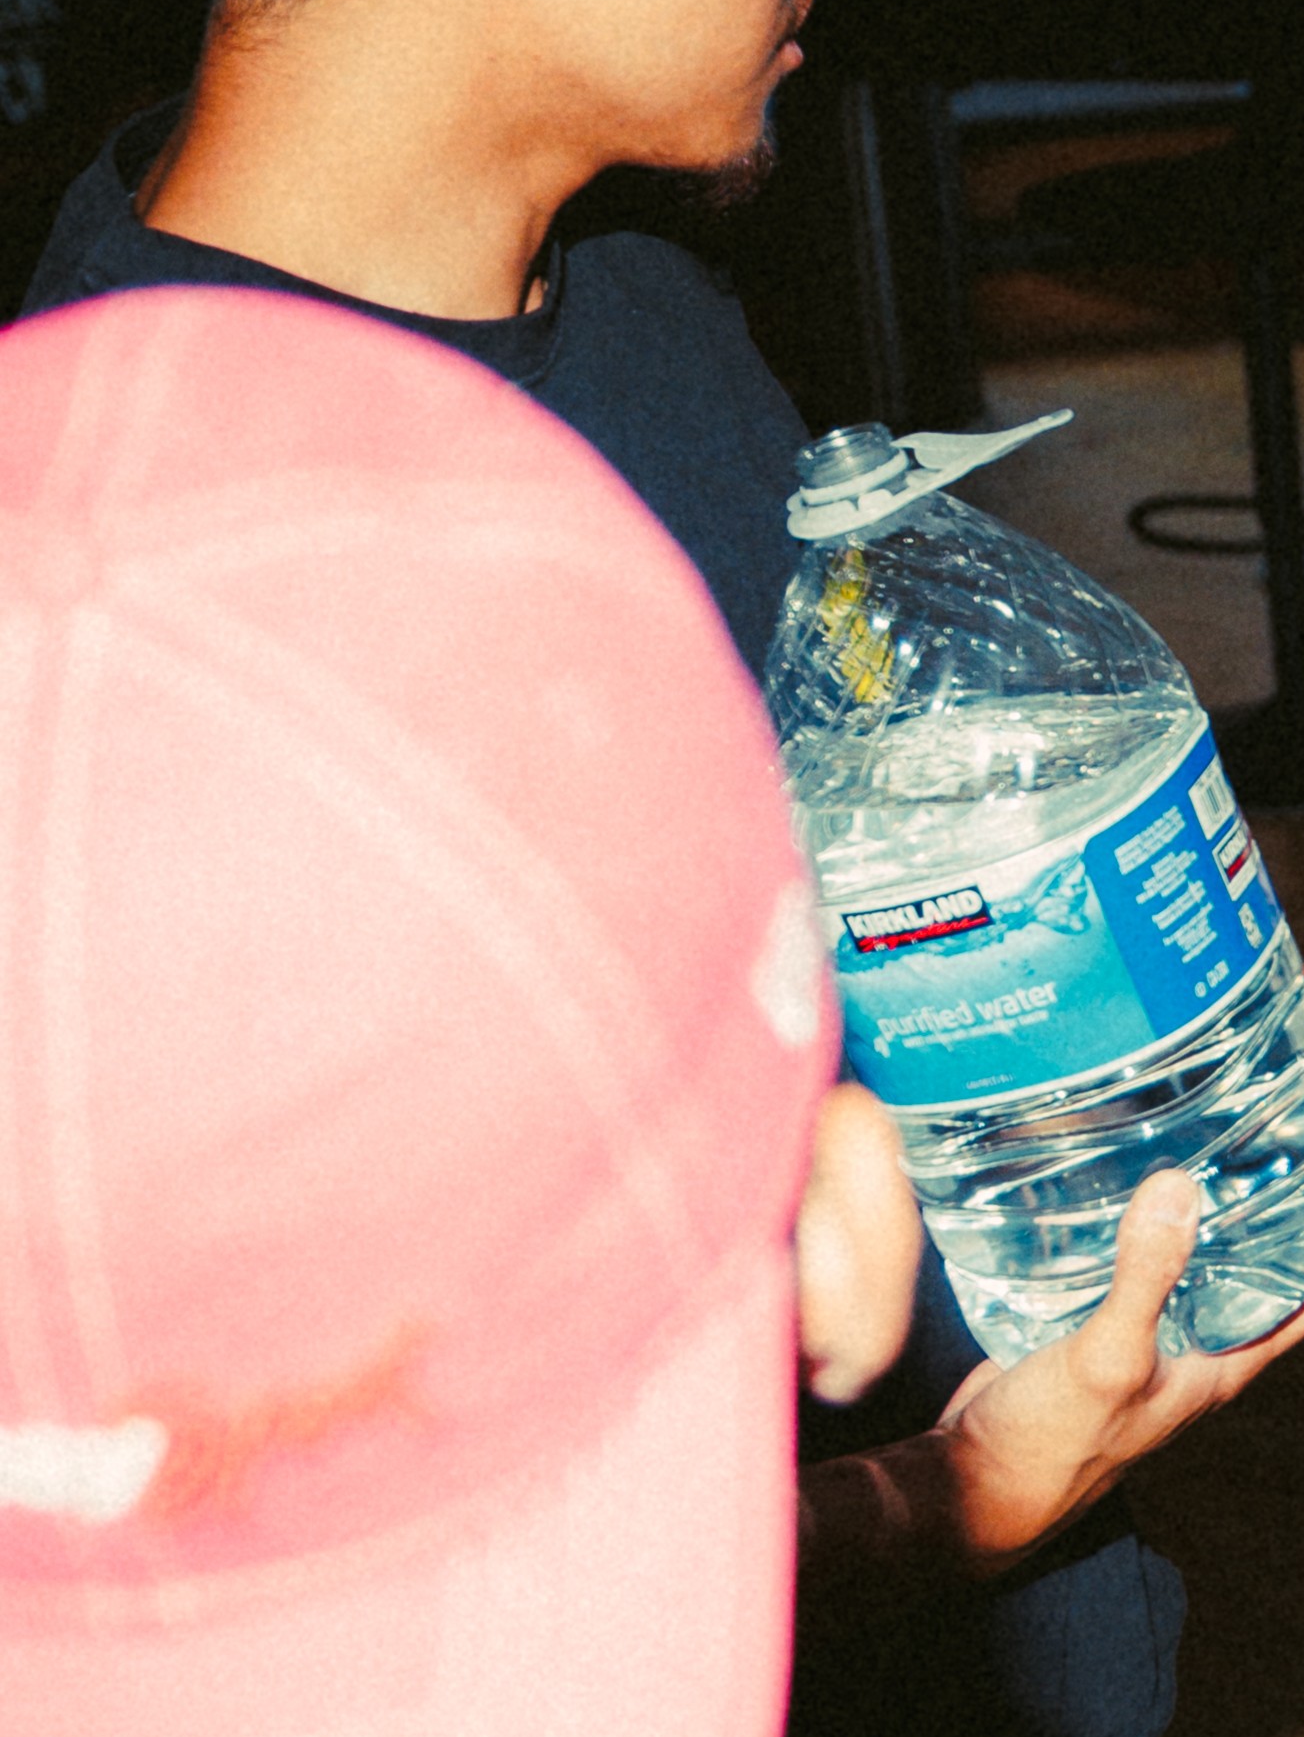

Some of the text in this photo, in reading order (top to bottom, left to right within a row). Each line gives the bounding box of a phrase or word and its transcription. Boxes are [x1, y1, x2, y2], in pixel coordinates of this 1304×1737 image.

[846, 889, 983, 938] KIRKLAND
[875, 999, 976, 1043] purified
[975, 980, 1059, 1021] water
